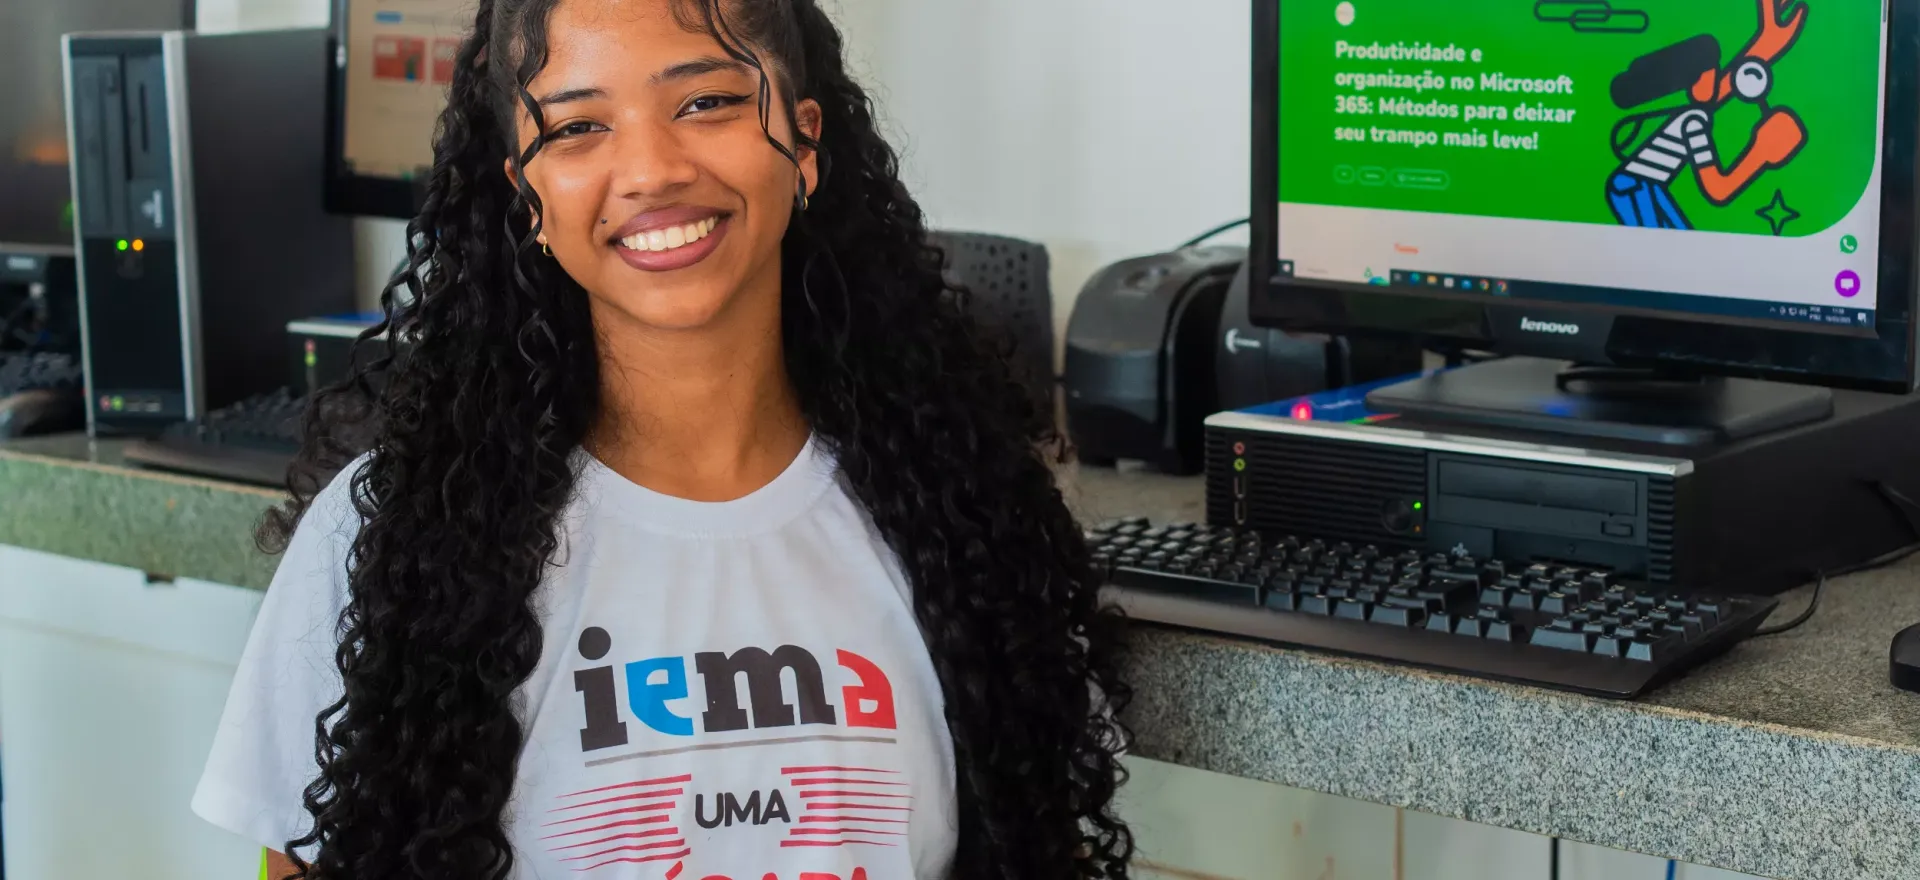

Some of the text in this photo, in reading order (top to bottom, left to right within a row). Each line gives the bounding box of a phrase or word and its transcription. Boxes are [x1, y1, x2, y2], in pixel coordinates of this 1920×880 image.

[1335, 40, 1482, 62] Produtividade e
[1335, 69, 1573, 94] organização no Microsoft
[1335, 95, 1576, 122] 365: Métodos para deixar
[1334, 126, 1539, 149] seu trampo mais leve!
[1521, 316, 1579, 334] lenovo
[574, 626, 897, 752] iema
[694, 788, 791, 829] UMA
